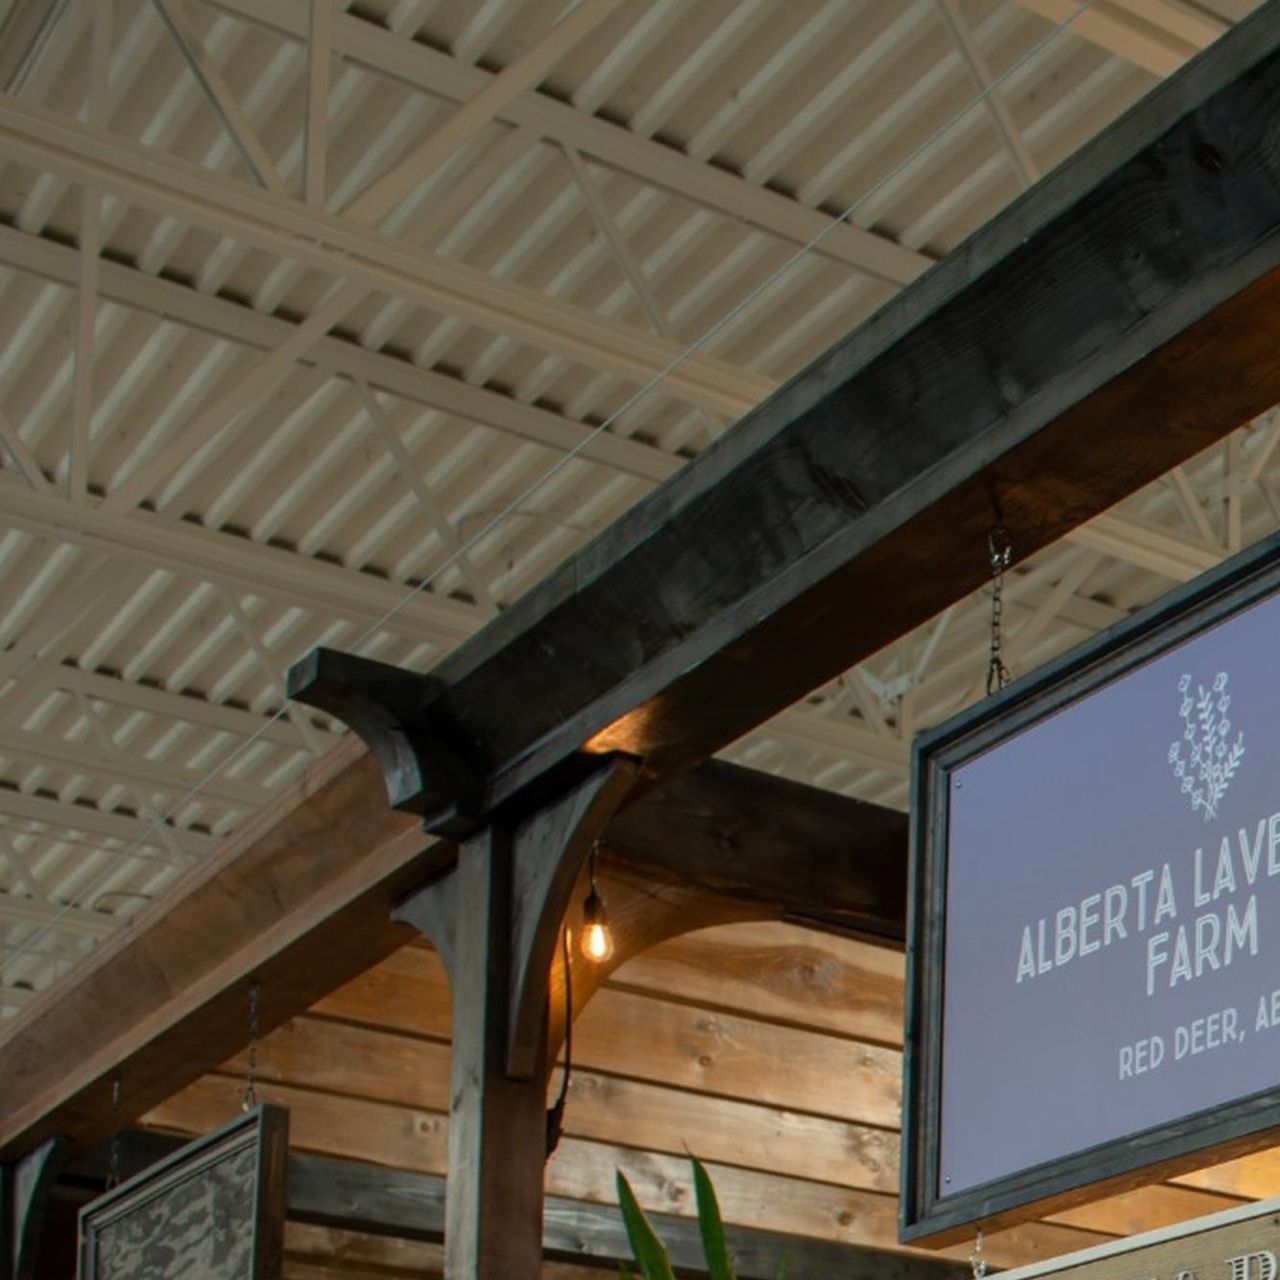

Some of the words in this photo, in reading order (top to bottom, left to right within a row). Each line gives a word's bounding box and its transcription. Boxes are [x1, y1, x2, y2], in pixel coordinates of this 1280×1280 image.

[1015, 864, 1179, 985] ALBERTA
[1145, 896, 1260, 996] FARM
[1117, 1037, 1164, 1081] RED
[1174, 1009, 1247, 1061] DEER,
